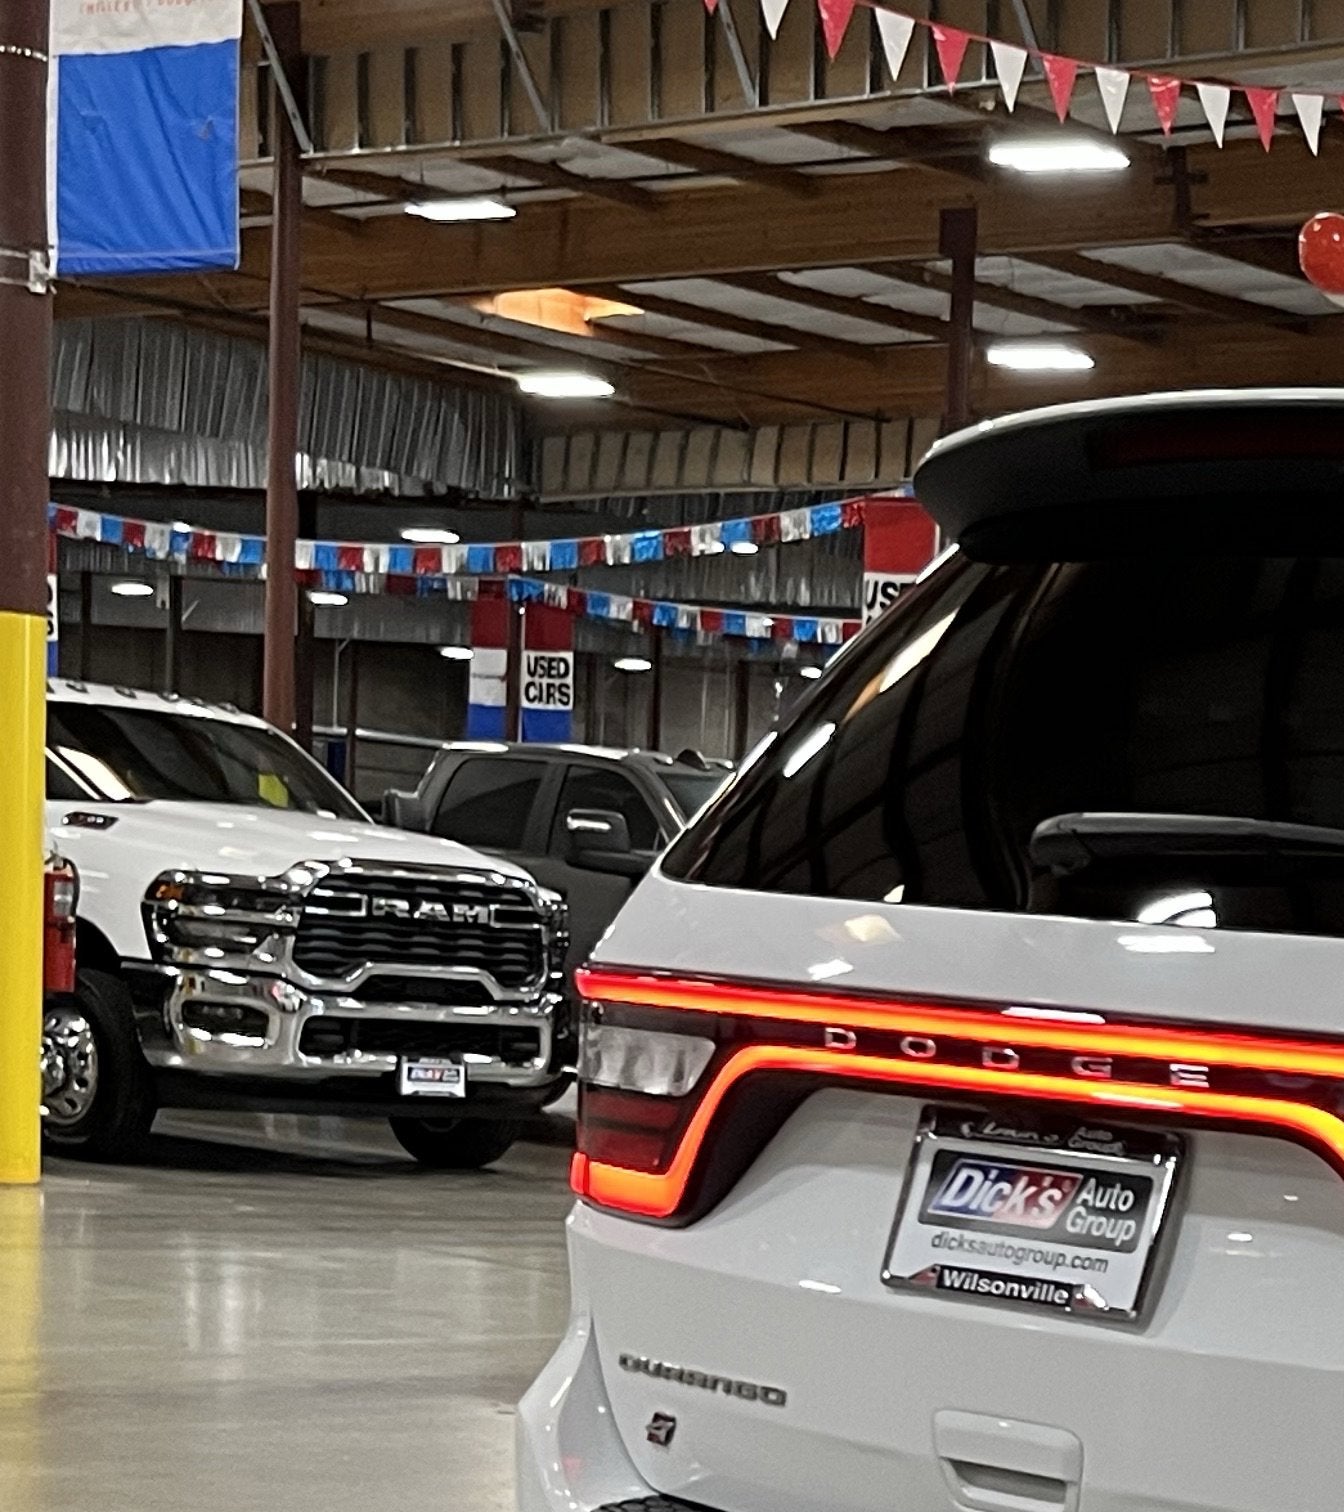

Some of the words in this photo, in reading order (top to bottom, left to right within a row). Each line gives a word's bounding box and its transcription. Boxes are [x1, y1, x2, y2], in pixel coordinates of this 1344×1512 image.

[866, 580, 899, 610] US
[526, 655, 570, 680] USED
[524, 681, 571, 706] CARS
[371, 896, 489, 924] RAM
[824, 1027, 1210, 1089] DODGE
[942, 1167, 1064, 1218] Dick's
[1076, 1177, 1135, 1212] Auto
[1066, 1206, 1137, 1247] Group
[931, 1231, 1109, 1274] dicksautogroup.com
[942, 1269, 1070, 1305] Wilsonville
[618, 1353, 788, 1407] DURANGO
